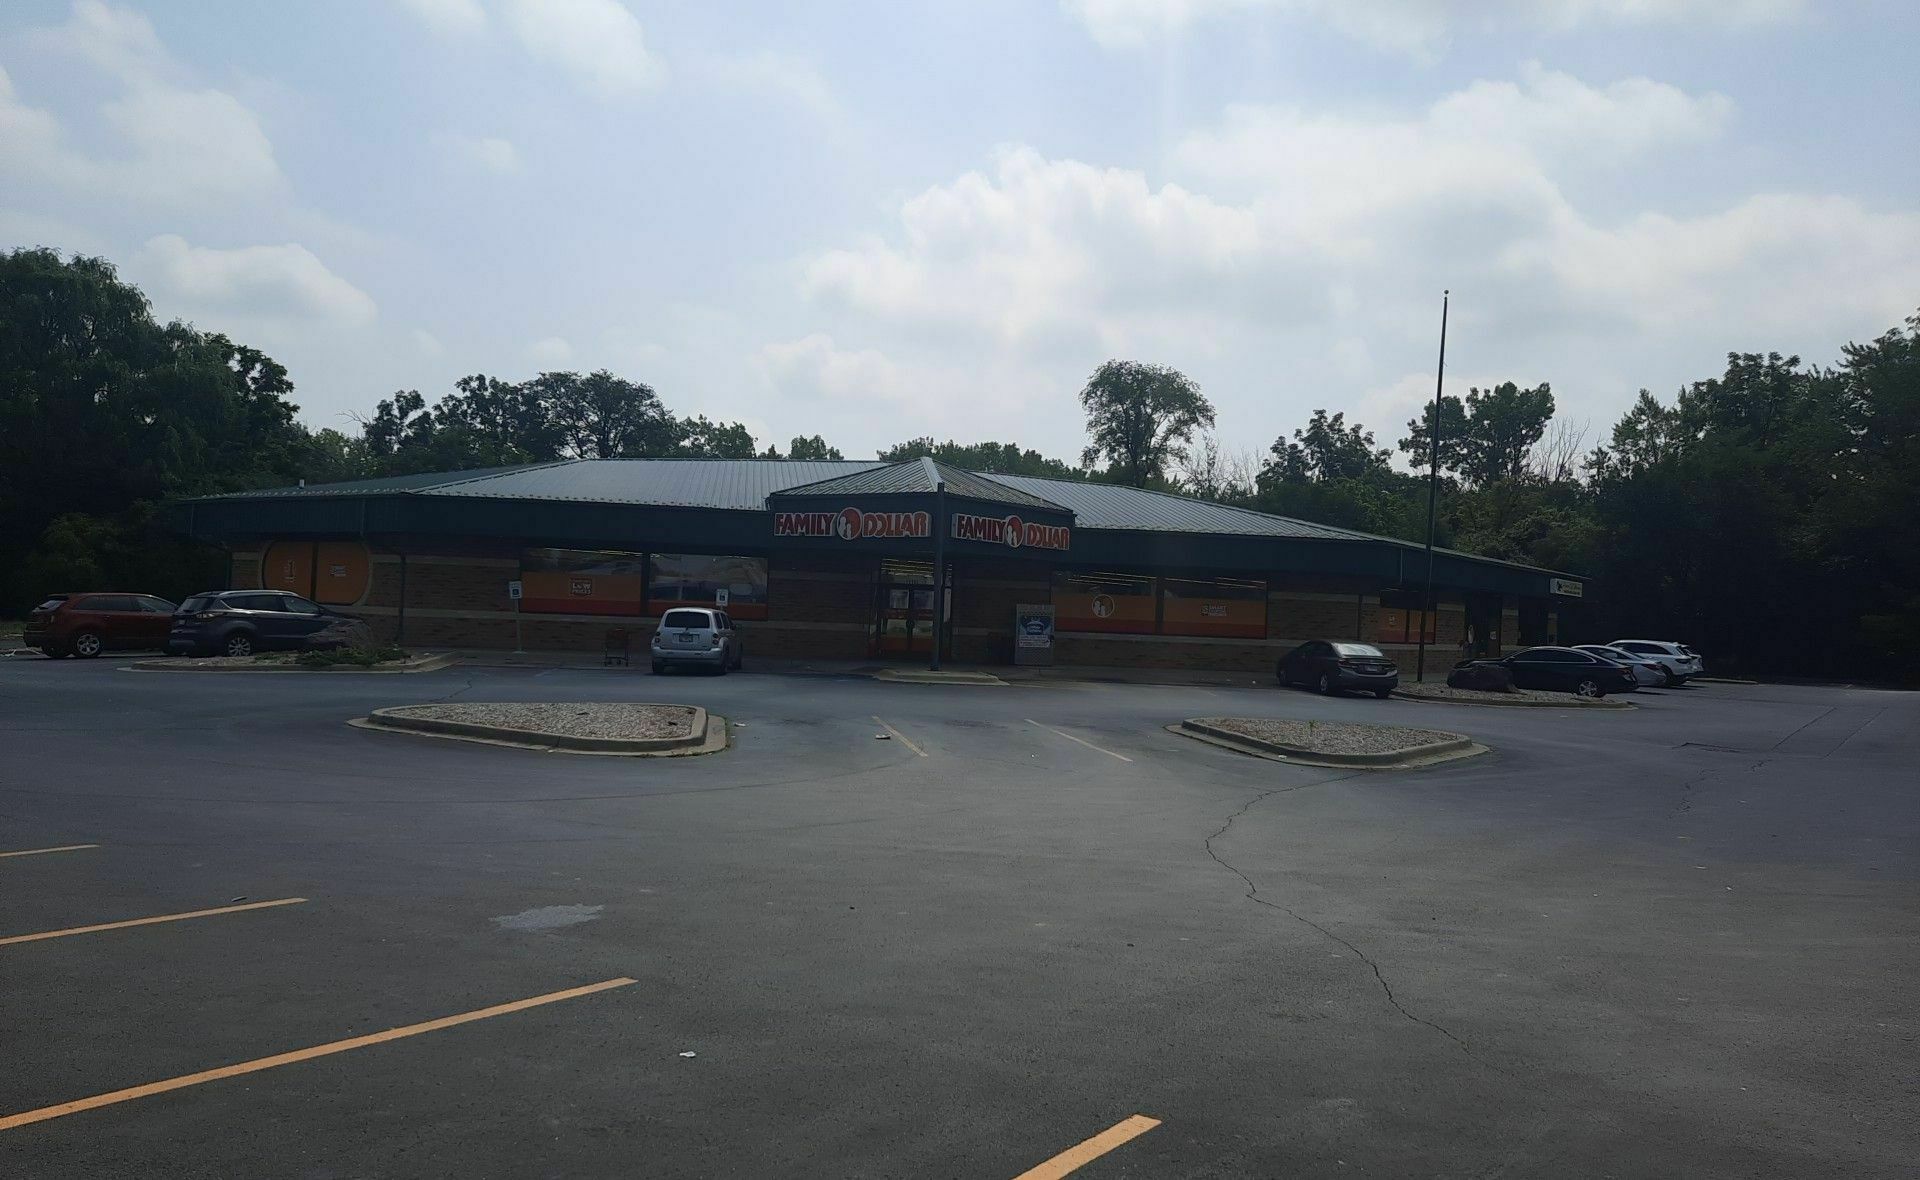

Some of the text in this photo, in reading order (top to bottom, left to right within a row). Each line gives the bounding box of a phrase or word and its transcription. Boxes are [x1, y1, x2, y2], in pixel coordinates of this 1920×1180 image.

[774, 510, 932, 538] FAMILY DOLLAR
[956, 513, 1070, 551] FAMILY DOLLAR
